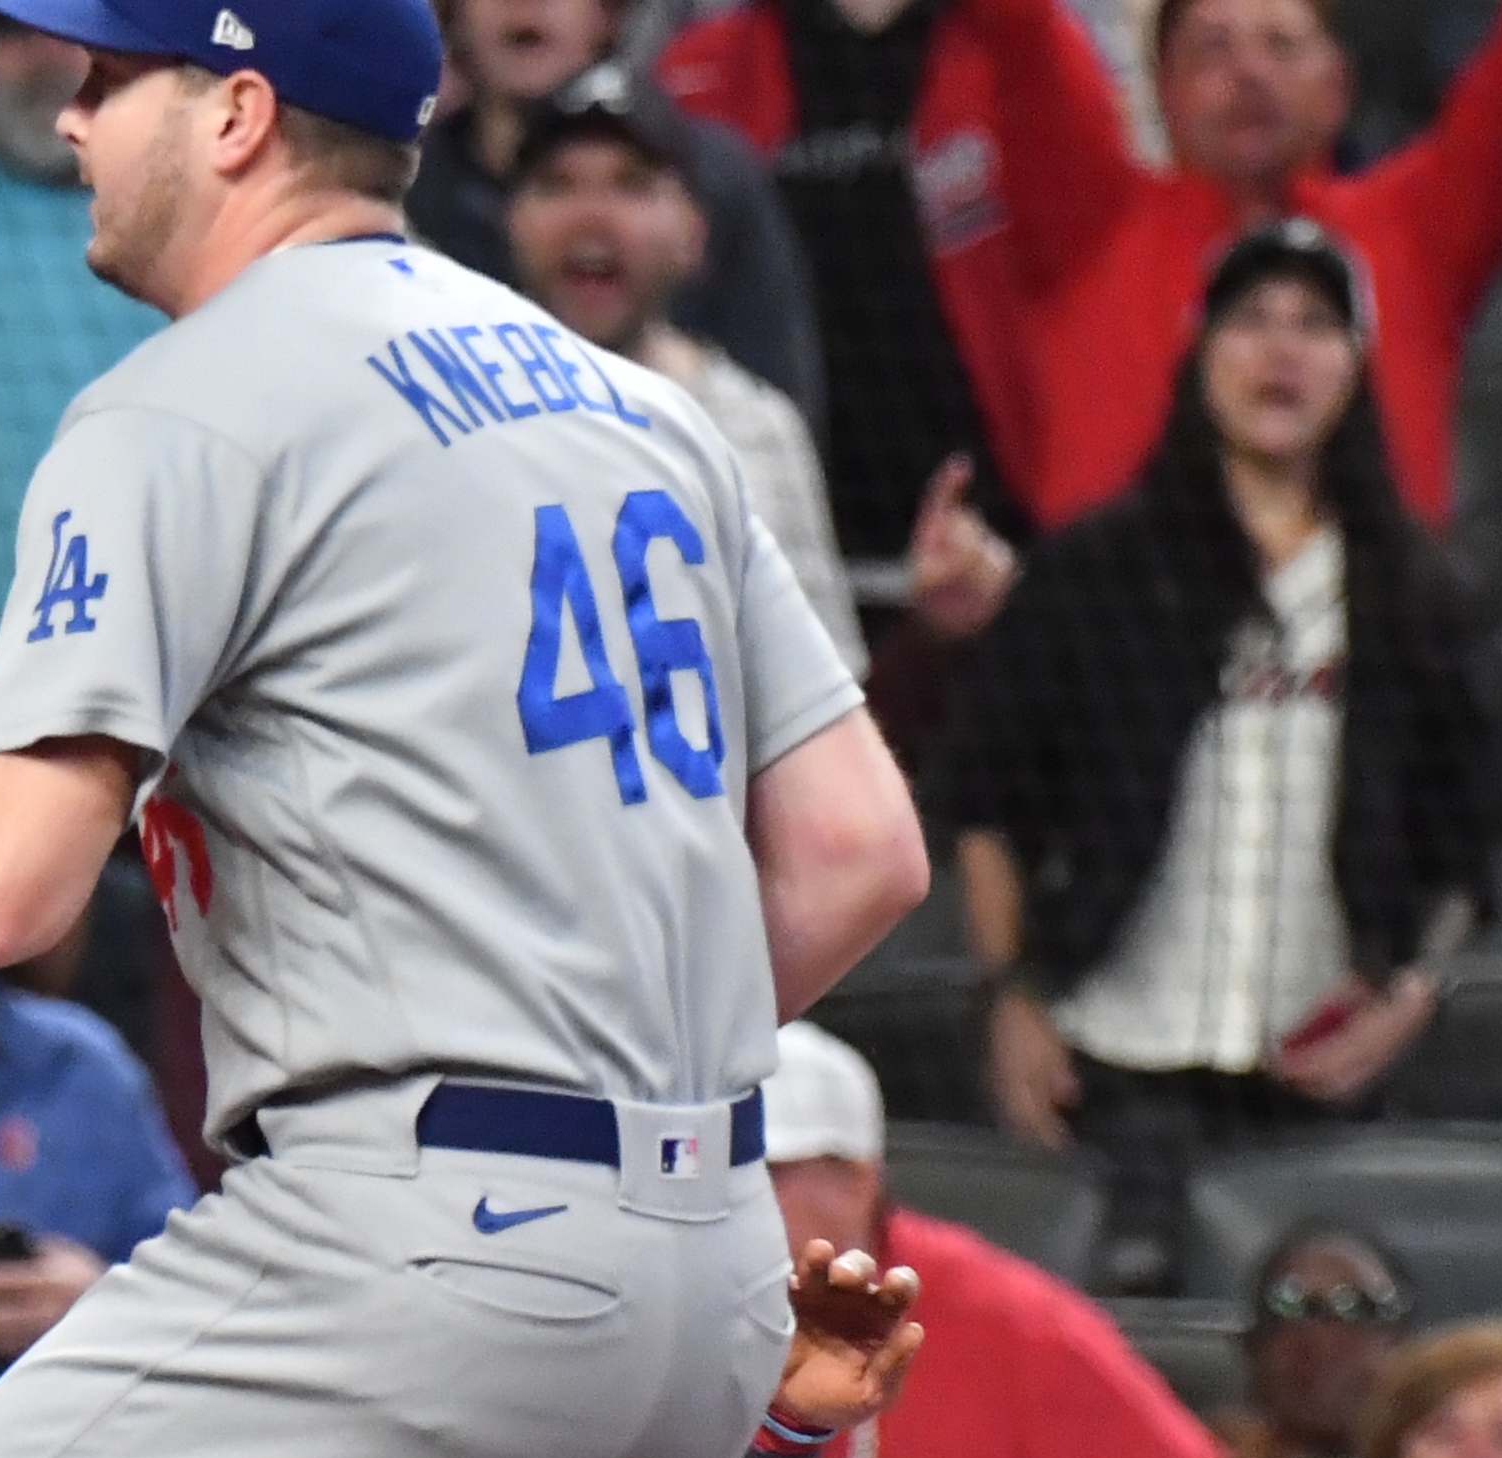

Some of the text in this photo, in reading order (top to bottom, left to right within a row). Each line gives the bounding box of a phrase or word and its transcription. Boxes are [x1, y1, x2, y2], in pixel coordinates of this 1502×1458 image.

[367, 322, 651, 448] KNEBEL
[26, 508, 109, 644] LA
[516, 489, 727, 807] 46
